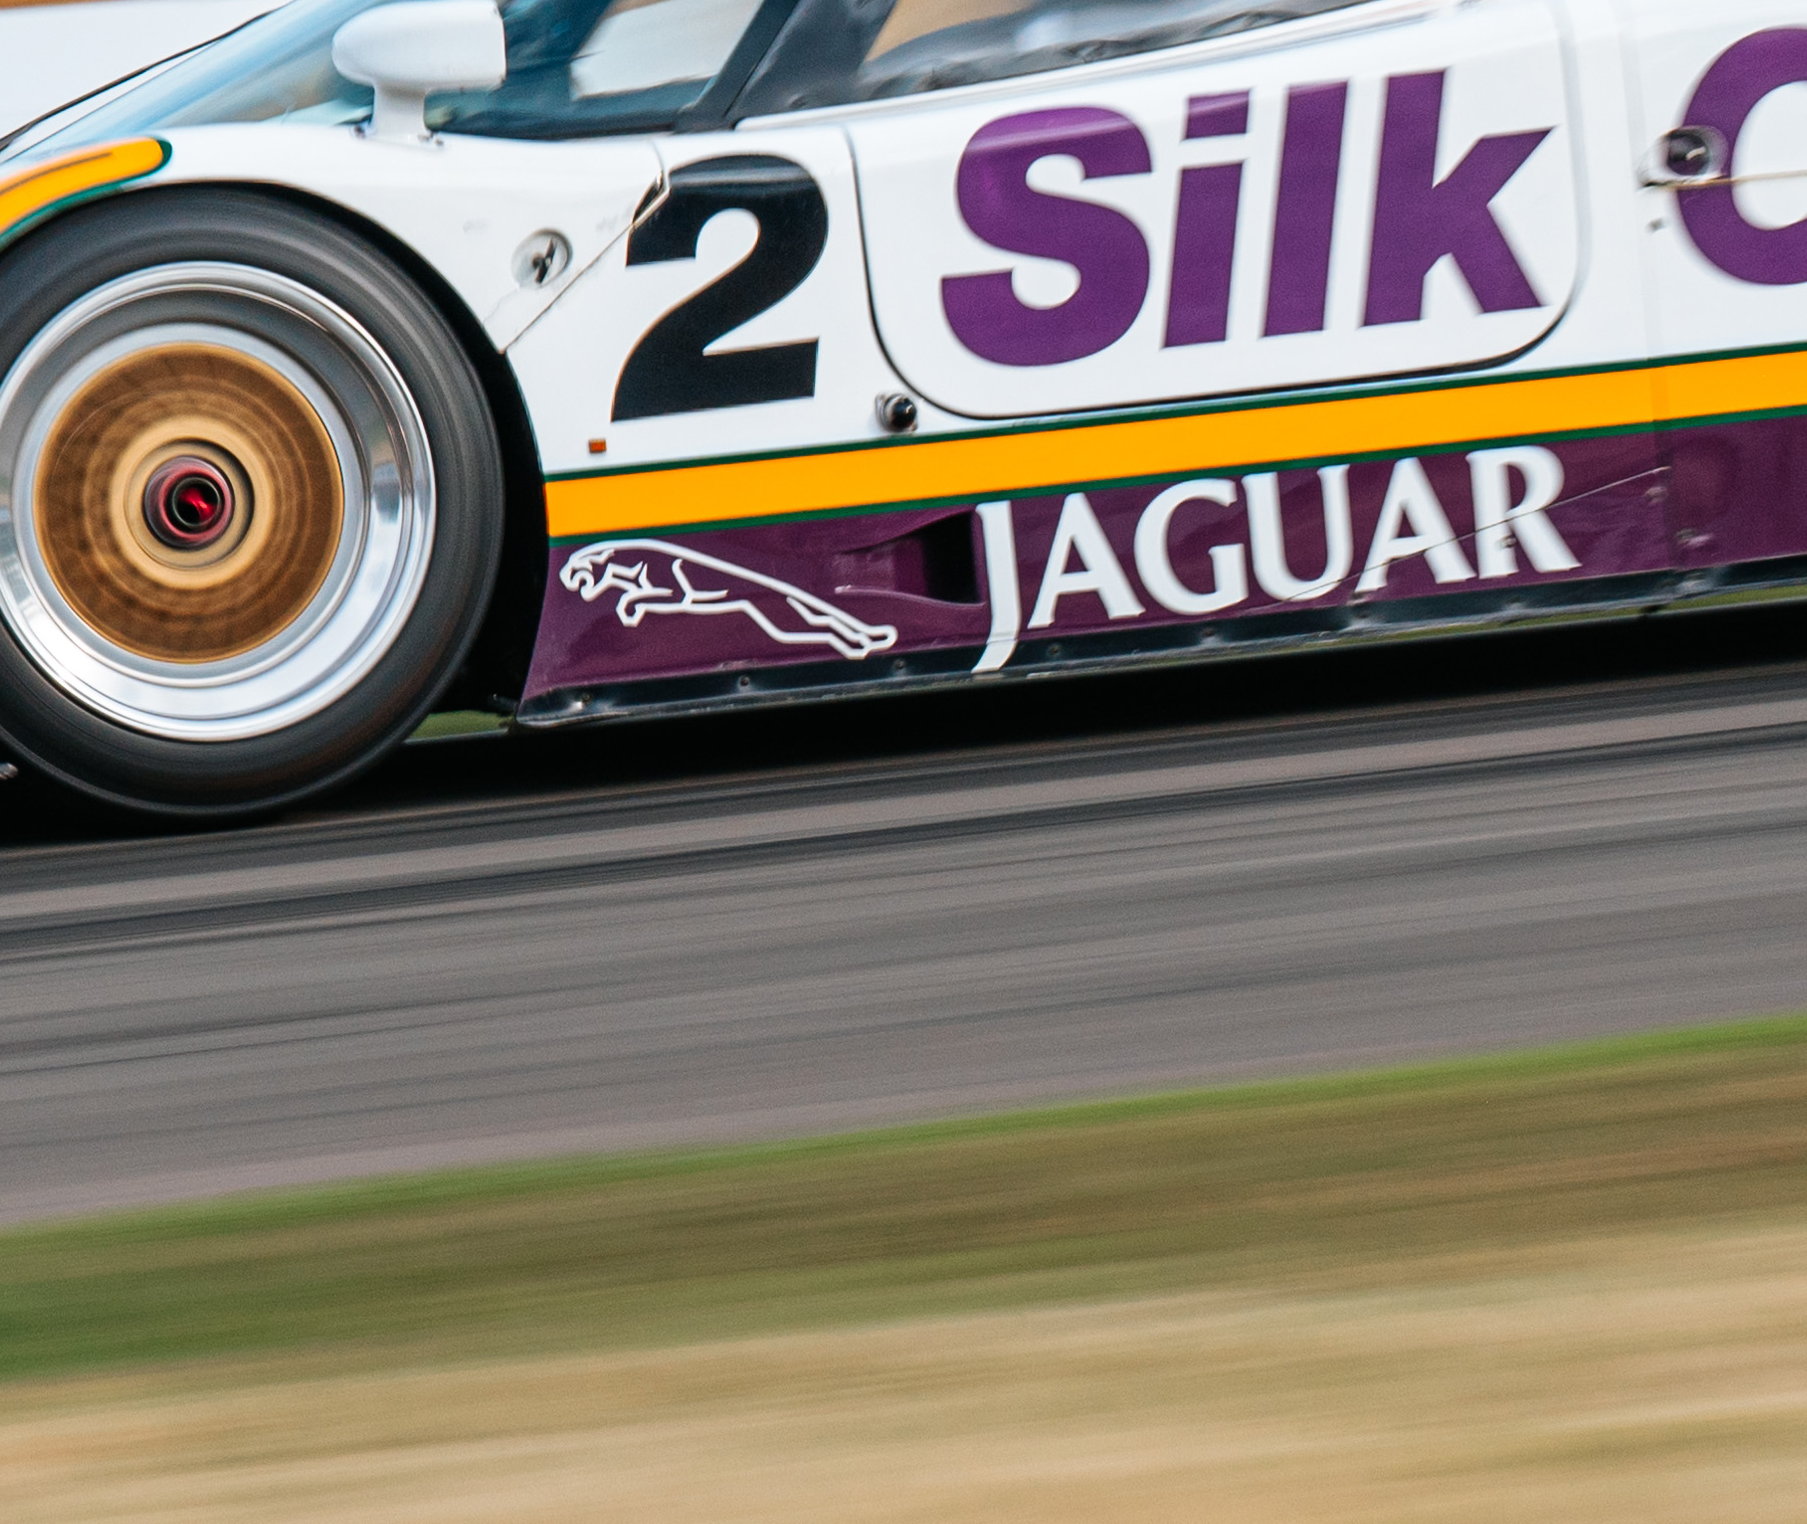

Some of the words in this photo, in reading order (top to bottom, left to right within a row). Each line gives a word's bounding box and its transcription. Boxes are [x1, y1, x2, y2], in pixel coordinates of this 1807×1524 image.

[611, 154, 828, 422] 2
[940, 66, 1560, 367] Silk
[971, 445, 1582, 674] JAGUAR
